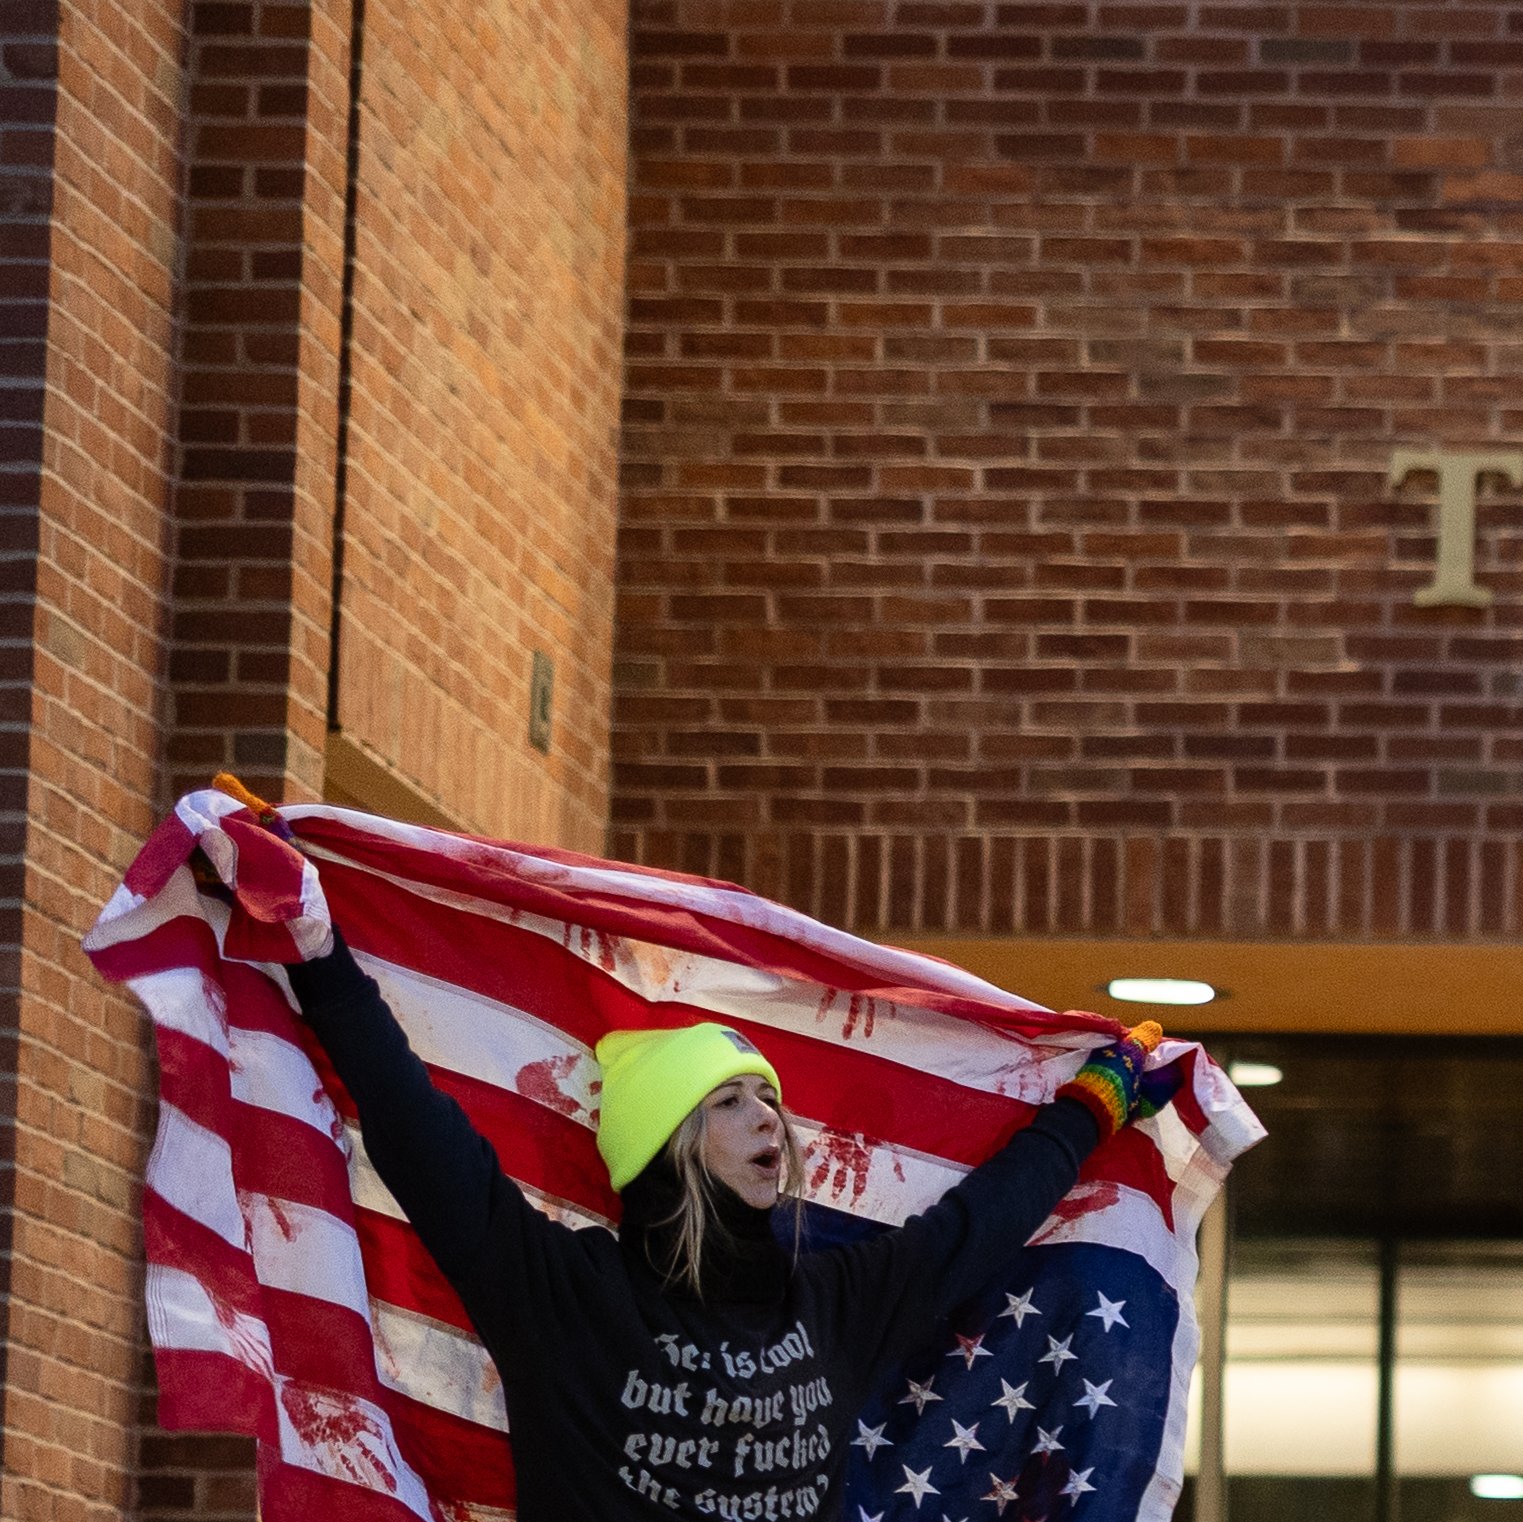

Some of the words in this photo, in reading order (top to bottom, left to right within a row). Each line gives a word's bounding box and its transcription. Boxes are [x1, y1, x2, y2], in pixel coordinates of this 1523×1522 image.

[620, 1368, 693, 1418] but
[700, 1387, 785, 1430] have
[789, 1375, 834, 1426] you
[622, 1432, 721, 1470] ever
[733, 1422, 832, 1480] fucked
